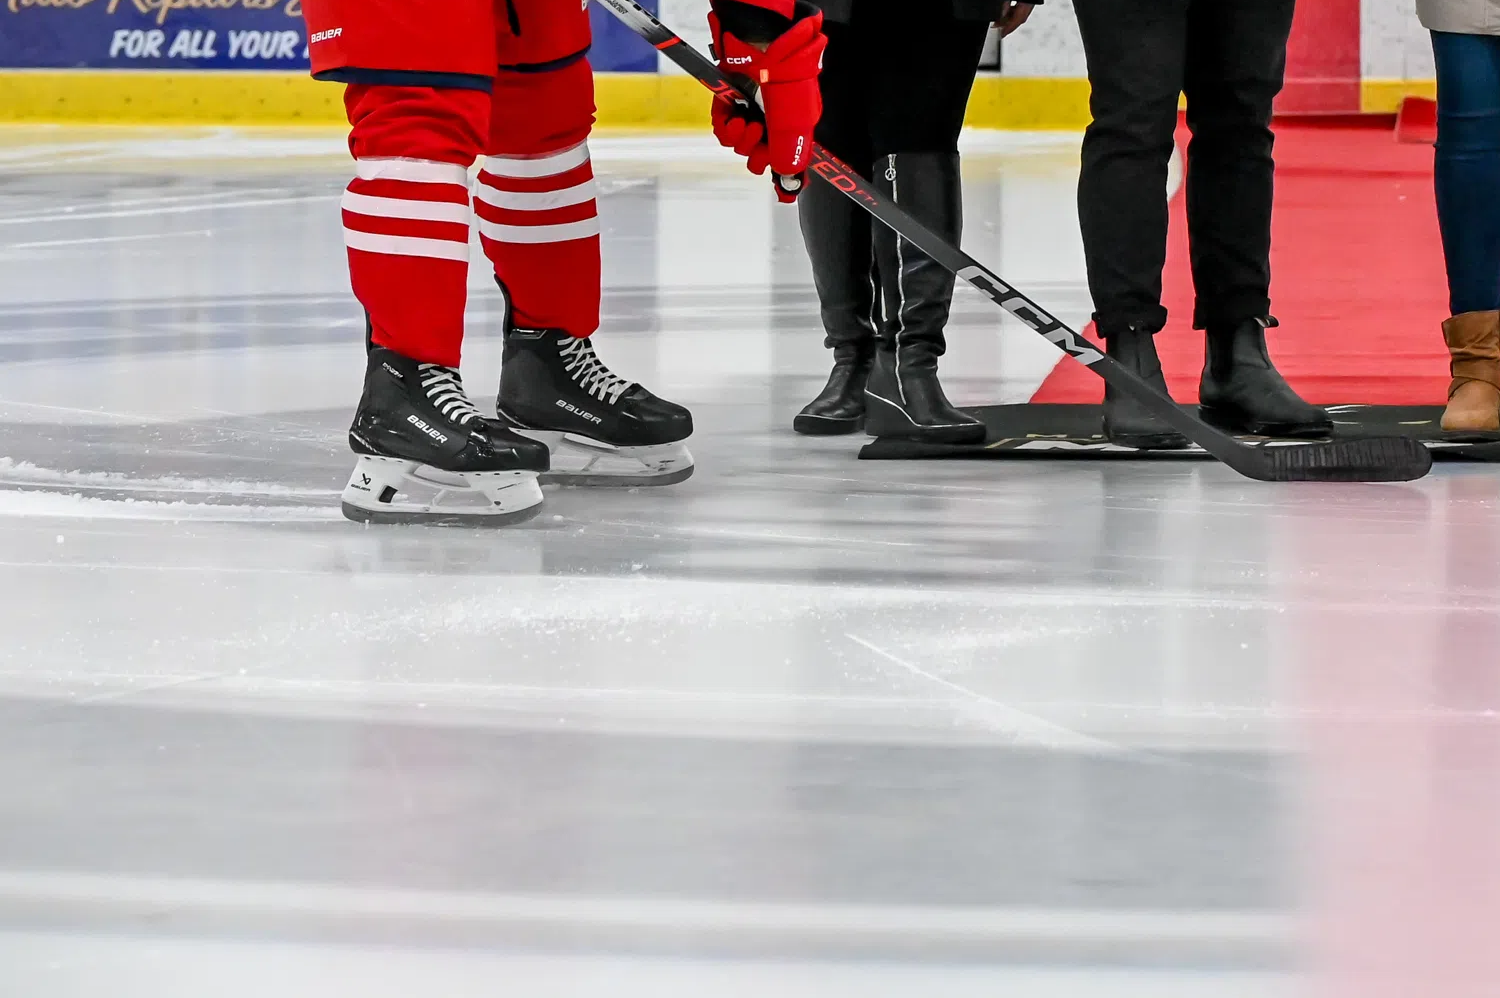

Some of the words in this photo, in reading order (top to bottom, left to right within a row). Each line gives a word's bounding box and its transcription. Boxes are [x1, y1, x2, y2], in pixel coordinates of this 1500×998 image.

[109, 28, 166, 59] FOR
[168, 28, 218, 59] ALL
[227, 28, 300, 60] YOUR
[311, 27, 343, 44] BAUER
[726, 55, 752, 65] CCM
[792, 135, 804, 166] CCM
[956, 265, 1105, 366] CCM
[556, 398, 602, 425] BAUER
[406, 414, 449, 444] BAUER
